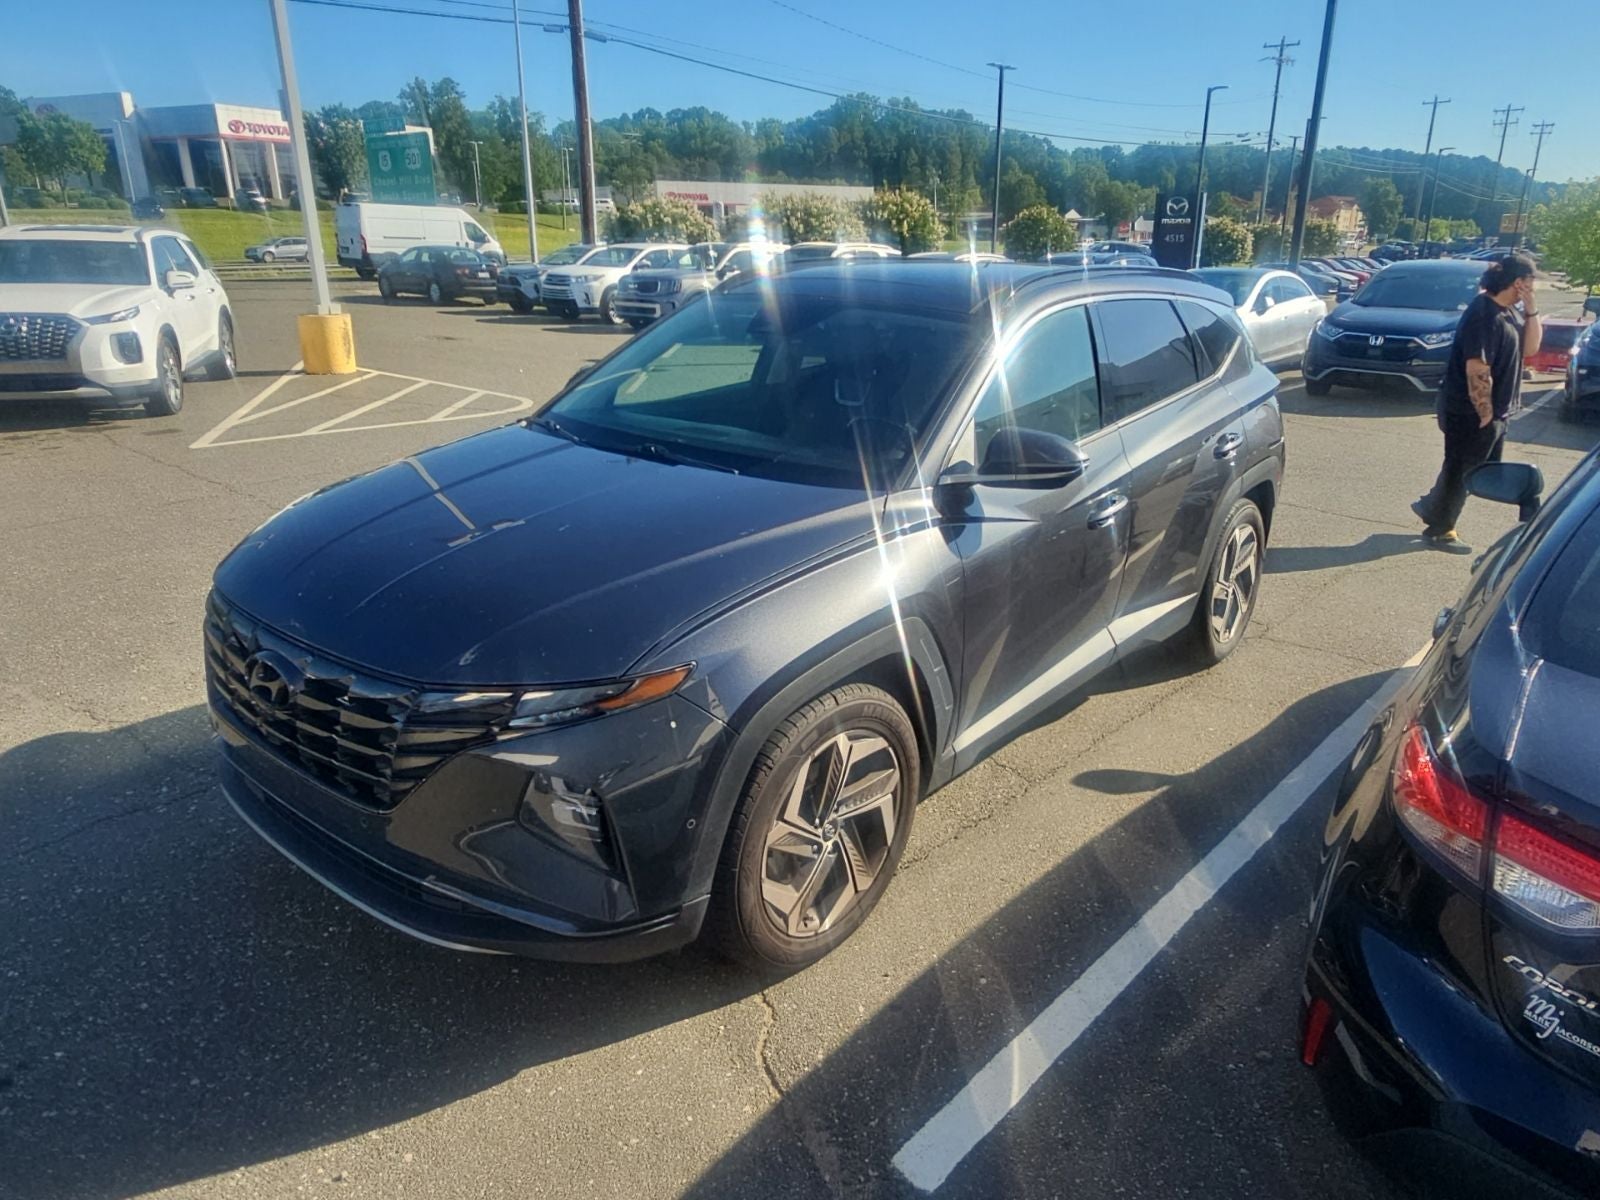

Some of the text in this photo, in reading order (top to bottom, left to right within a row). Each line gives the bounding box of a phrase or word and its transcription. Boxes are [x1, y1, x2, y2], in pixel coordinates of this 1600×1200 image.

[246, 122, 290, 136] TOYOTA
[1165, 233, 1185, 243] 4515
[1523, 1009, 1551, 1028] MARK
